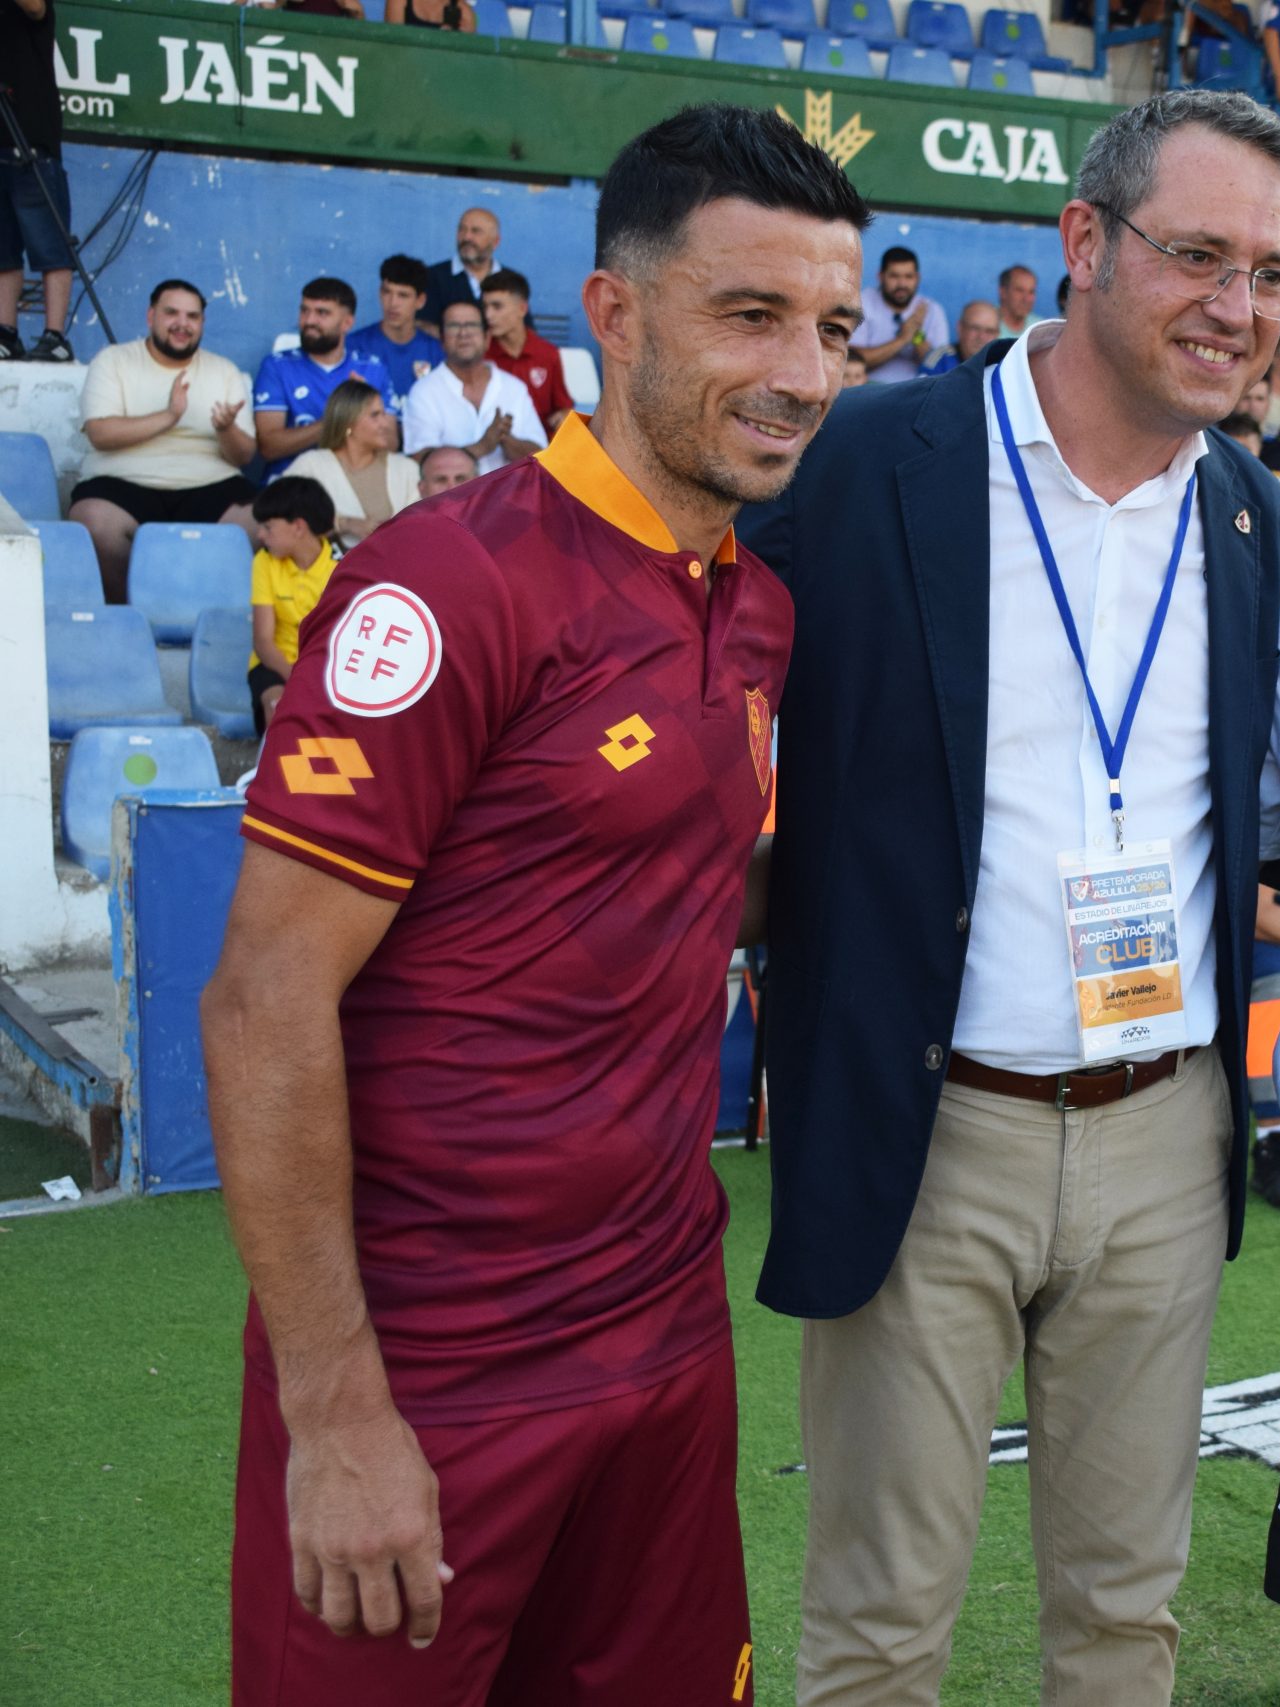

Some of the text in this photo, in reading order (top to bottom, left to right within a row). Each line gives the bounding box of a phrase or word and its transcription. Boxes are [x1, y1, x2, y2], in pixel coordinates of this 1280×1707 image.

[158, 35, 359, 118] JAÉN
[922, 118, 1069, 185] CAJA
[1091, 870, 1166, 888] PRETEMPORADA
[1075, 898, 1168, 921] ESTADIO DE LINAREJOS
[1079, 919, 1167, 945] ACREDITACIÓN
[1096, 937, 1156, 964] CLUB
[1130, 983, 1157, 996] Vallejo
